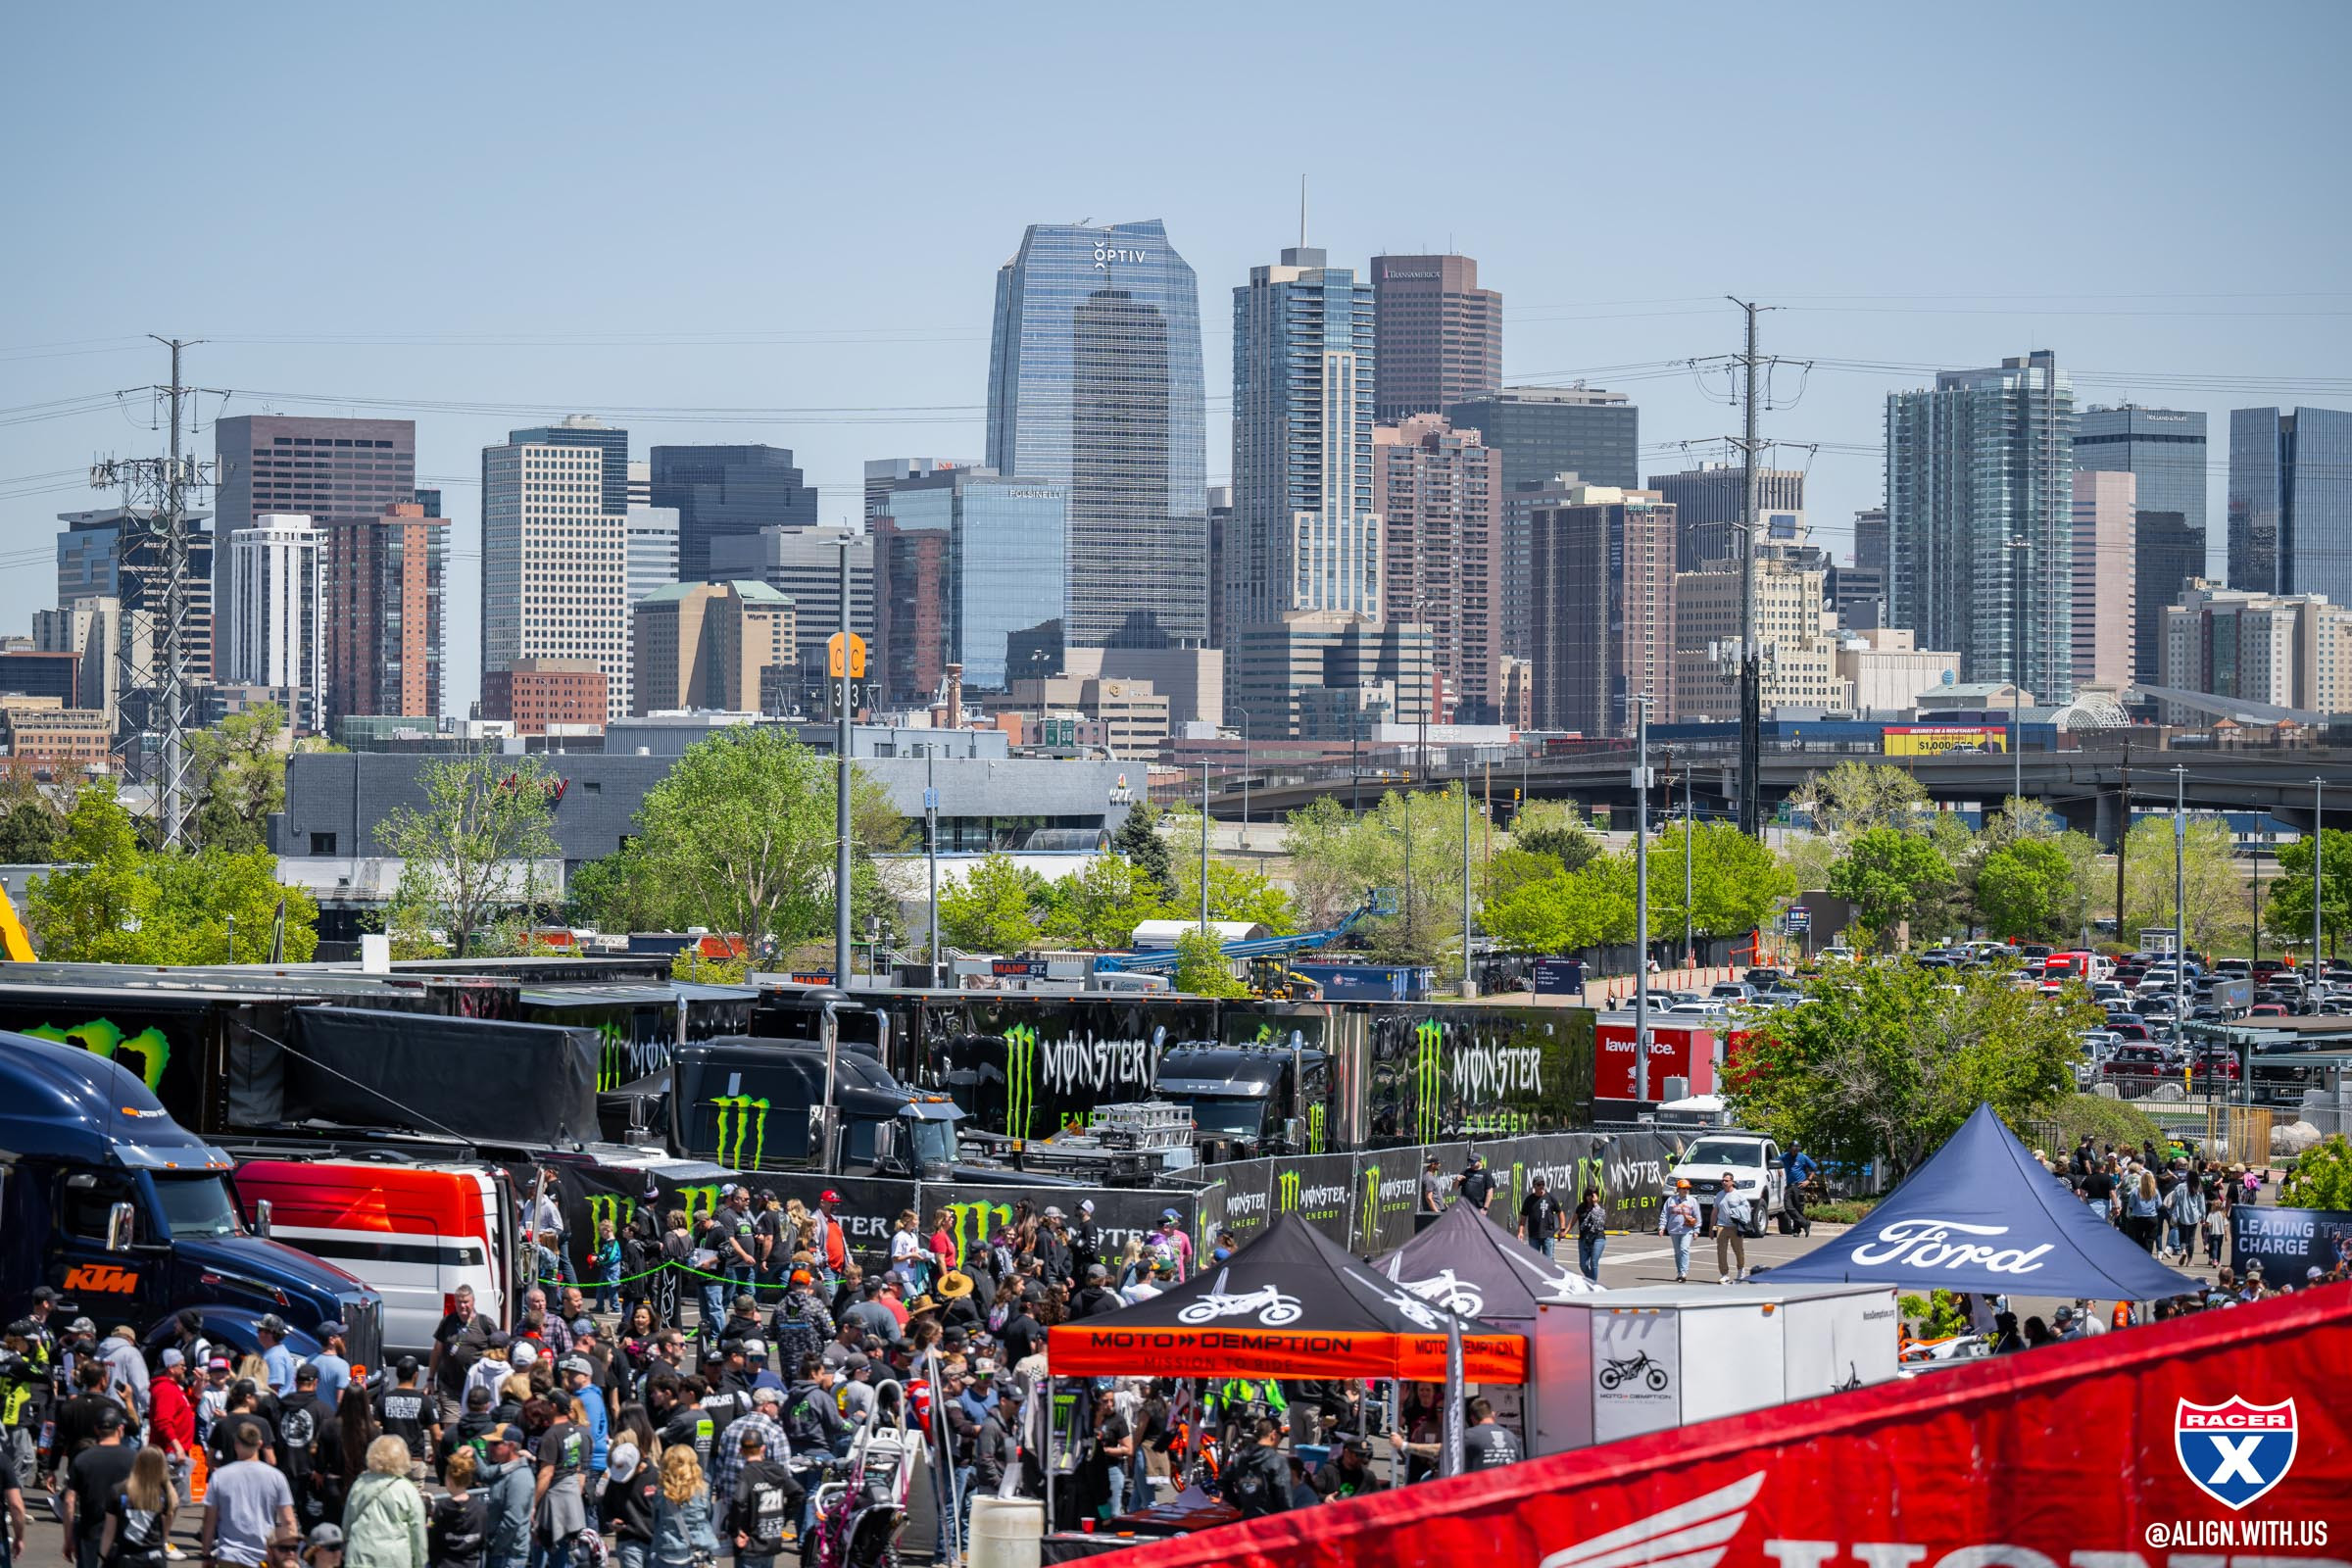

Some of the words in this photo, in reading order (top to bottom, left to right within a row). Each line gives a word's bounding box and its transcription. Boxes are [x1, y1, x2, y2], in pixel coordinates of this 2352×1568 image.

[1094, 247, 1146, 265] OPTIV
[1009, 489, 1061, 499] POLSINELLI
[835, 648, 842, 670] C
[851, 649, 858, 671] C
[834, 683, 842, 707] 3
[851, 683, 858, 707] 3
[1030, 964, 1046, 974] ST.
[1466, 1113, 1529, 1135] ENERGY
[1305, 1210, 1339, 1221] ENERGY
[2238, 1218, 2314, 1238] LEADING
[1851, 1218, 2055, 1274] Ford
[2238, 1237, 2309, 1255] CHARGE
[63, 1263, 139, 1295] KTM
[1091, 1333, 1174, 1348] MOTO
[1200, 1333, 1351, 1352] DEMPTION
[1415, 1340, 1446, 1354] MOTO
[1144, 1356, 1215, 1369] MISSION
[1226, 1356, 1246, 1369] TO
[1253, 1358, 1294, 1371] RIDE
[758, 1489, 783, 1513] 221
